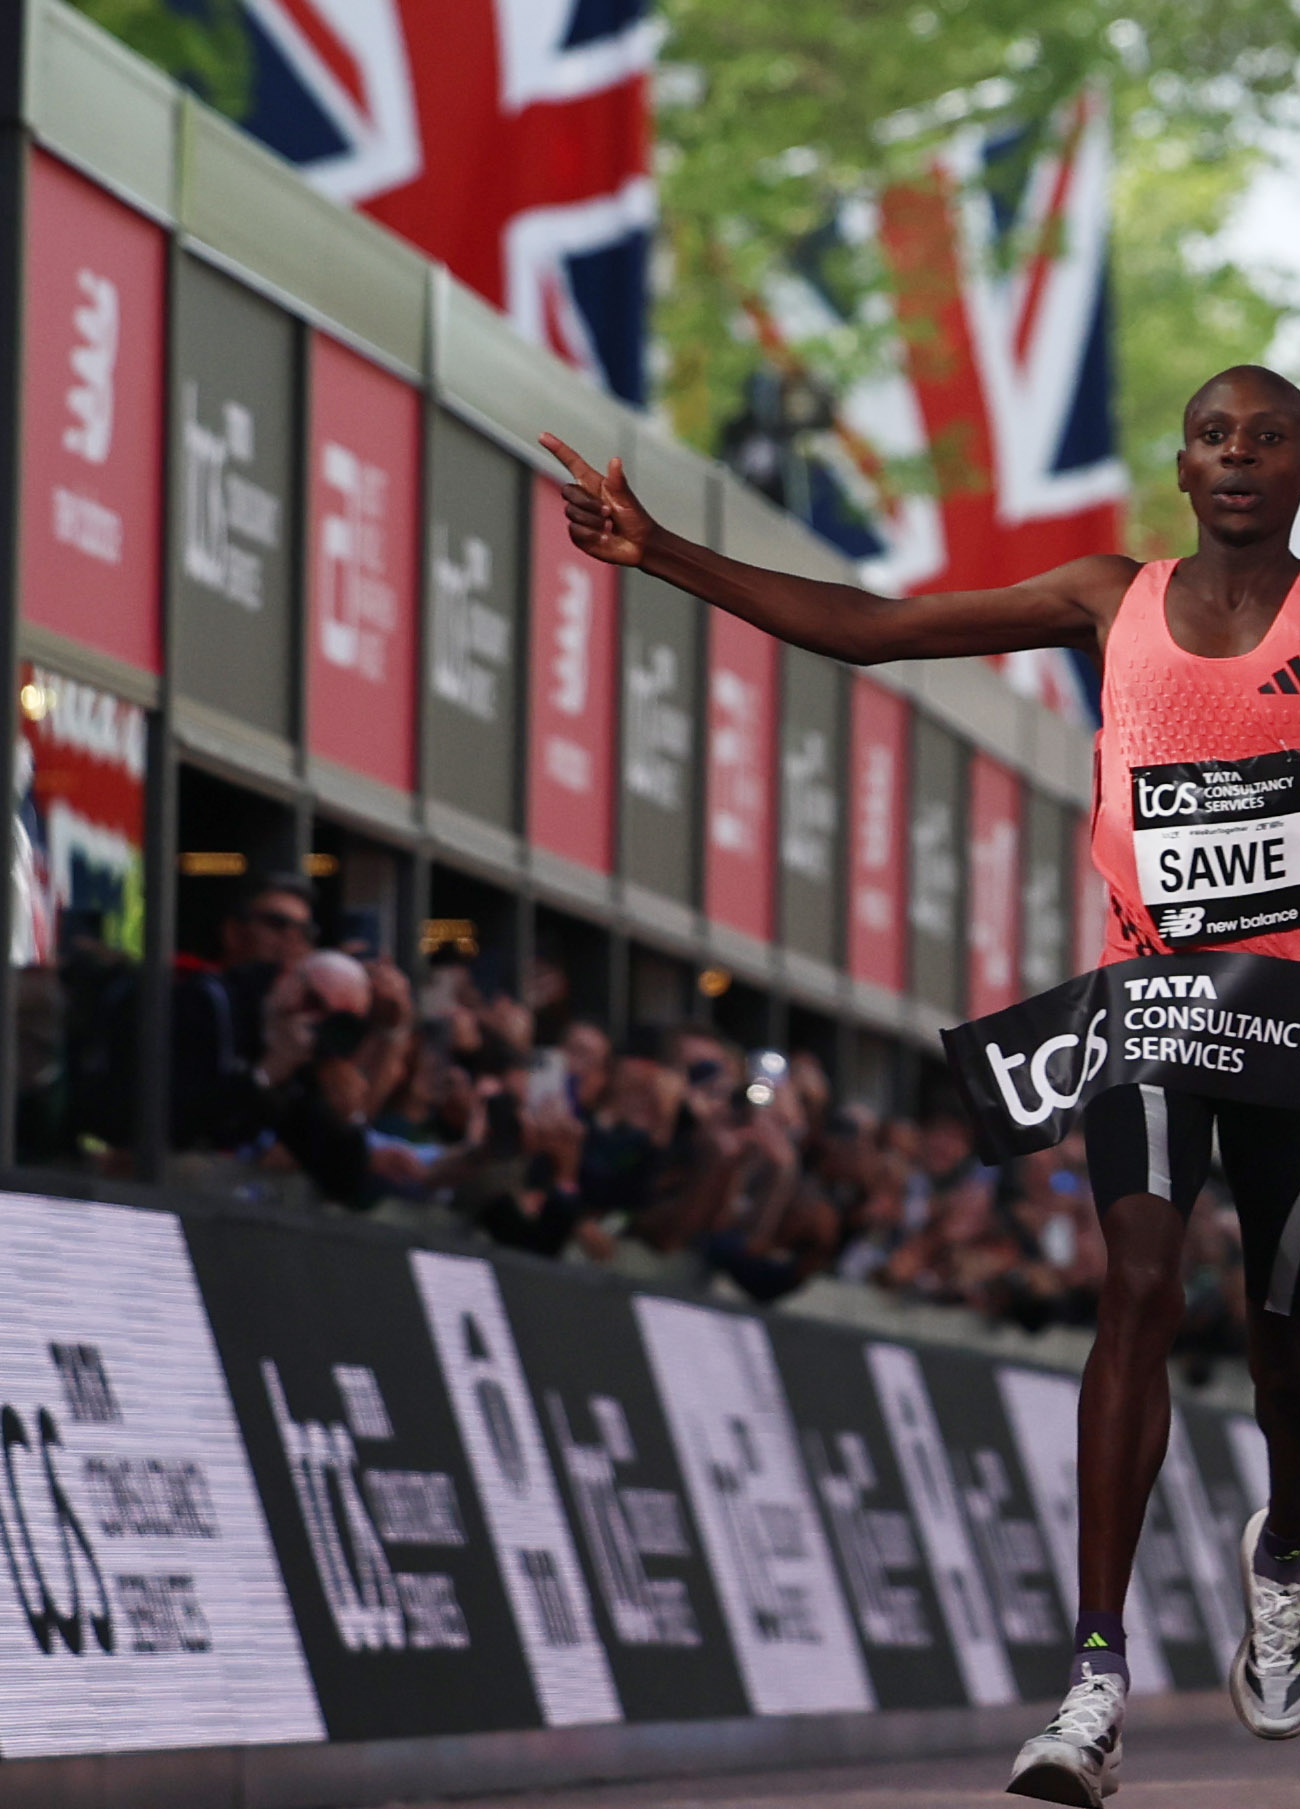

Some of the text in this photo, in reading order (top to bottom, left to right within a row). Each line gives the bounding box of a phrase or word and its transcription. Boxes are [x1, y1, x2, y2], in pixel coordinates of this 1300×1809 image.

[1202, 771, 1242, 784] TATA
[1203, 776, 1295, 799] CONSULTANCY
[1138, 777, 1198, 818] tcs
[1204, 796, 1265, 813] SERVICES
[1159, 837, 1287, 893] SAWE
[1206, 908, 1299, 934] new balance
[1124, 975, 1218, 1001] TATA
[1124, 1037, 1244, 1074] SERVICES
